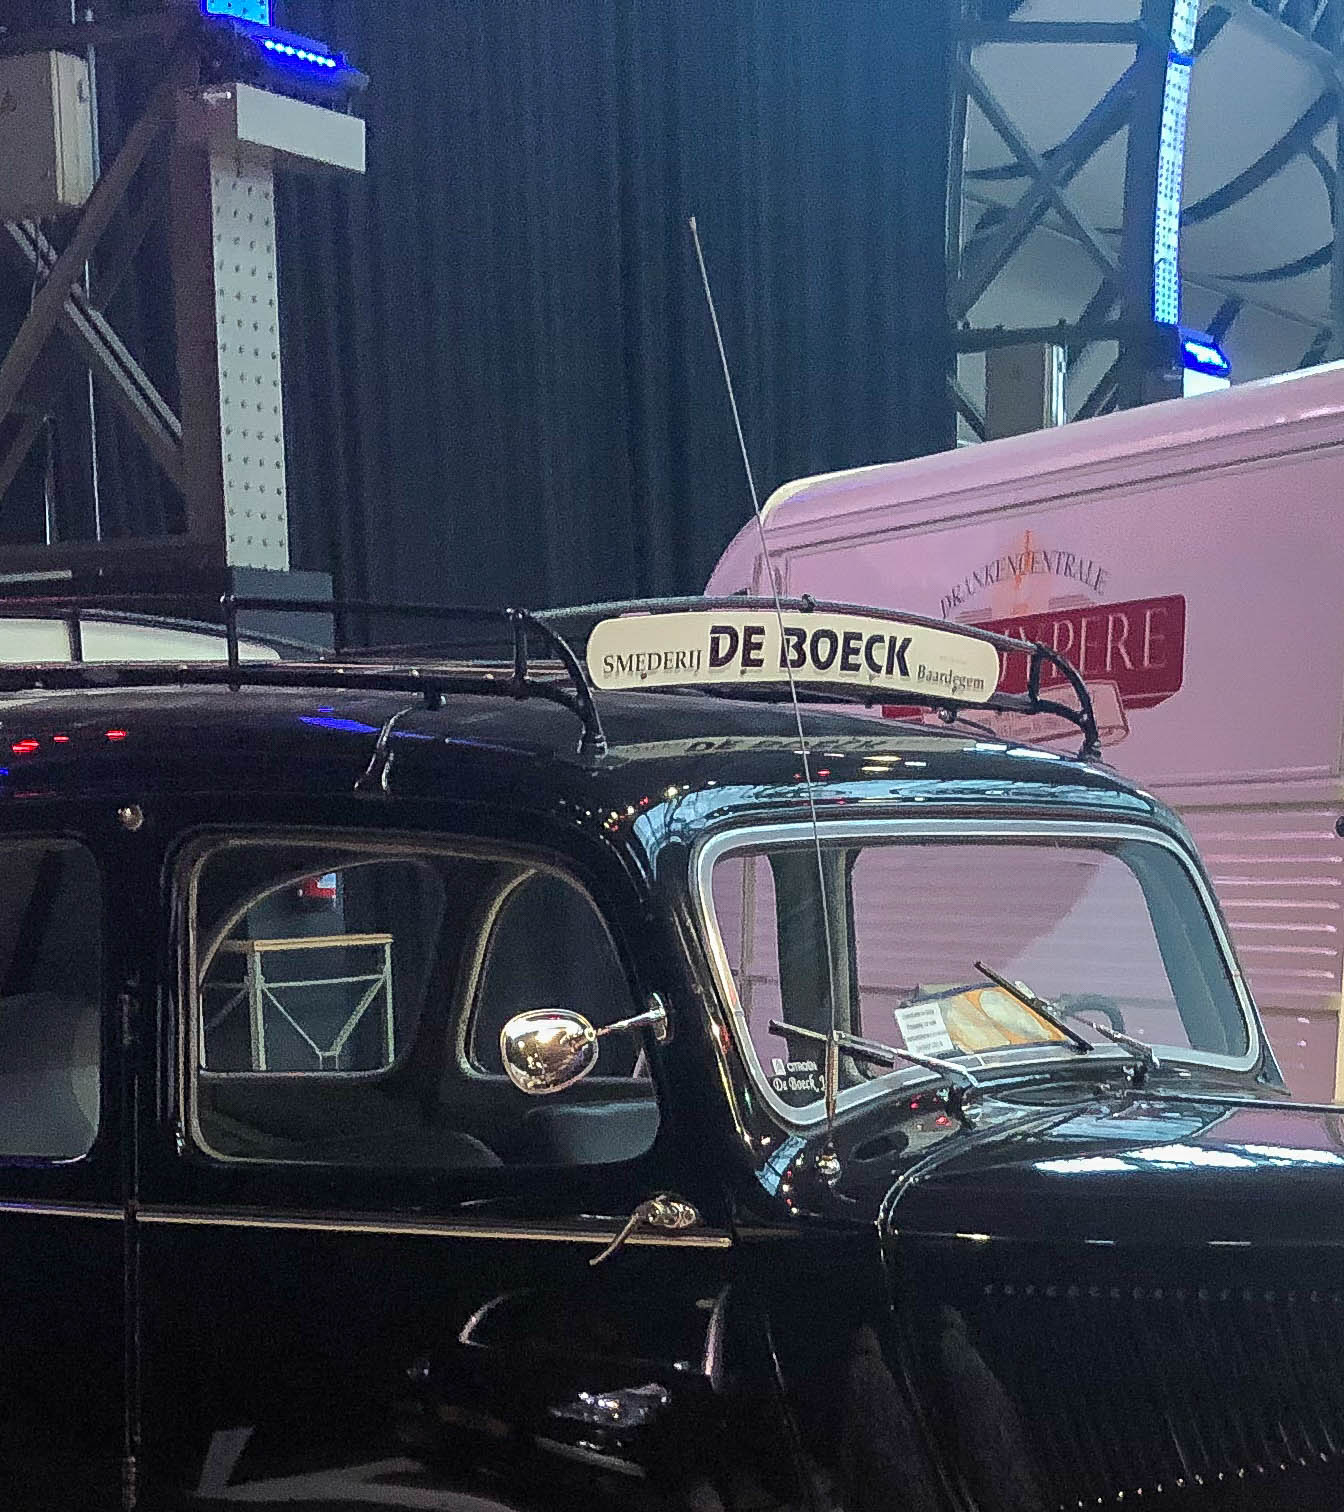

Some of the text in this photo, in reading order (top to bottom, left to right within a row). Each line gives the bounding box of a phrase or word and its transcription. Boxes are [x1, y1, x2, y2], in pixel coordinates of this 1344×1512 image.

[602, 624, 985, 690] SMEDERIJ DE BOECK Baardegem
